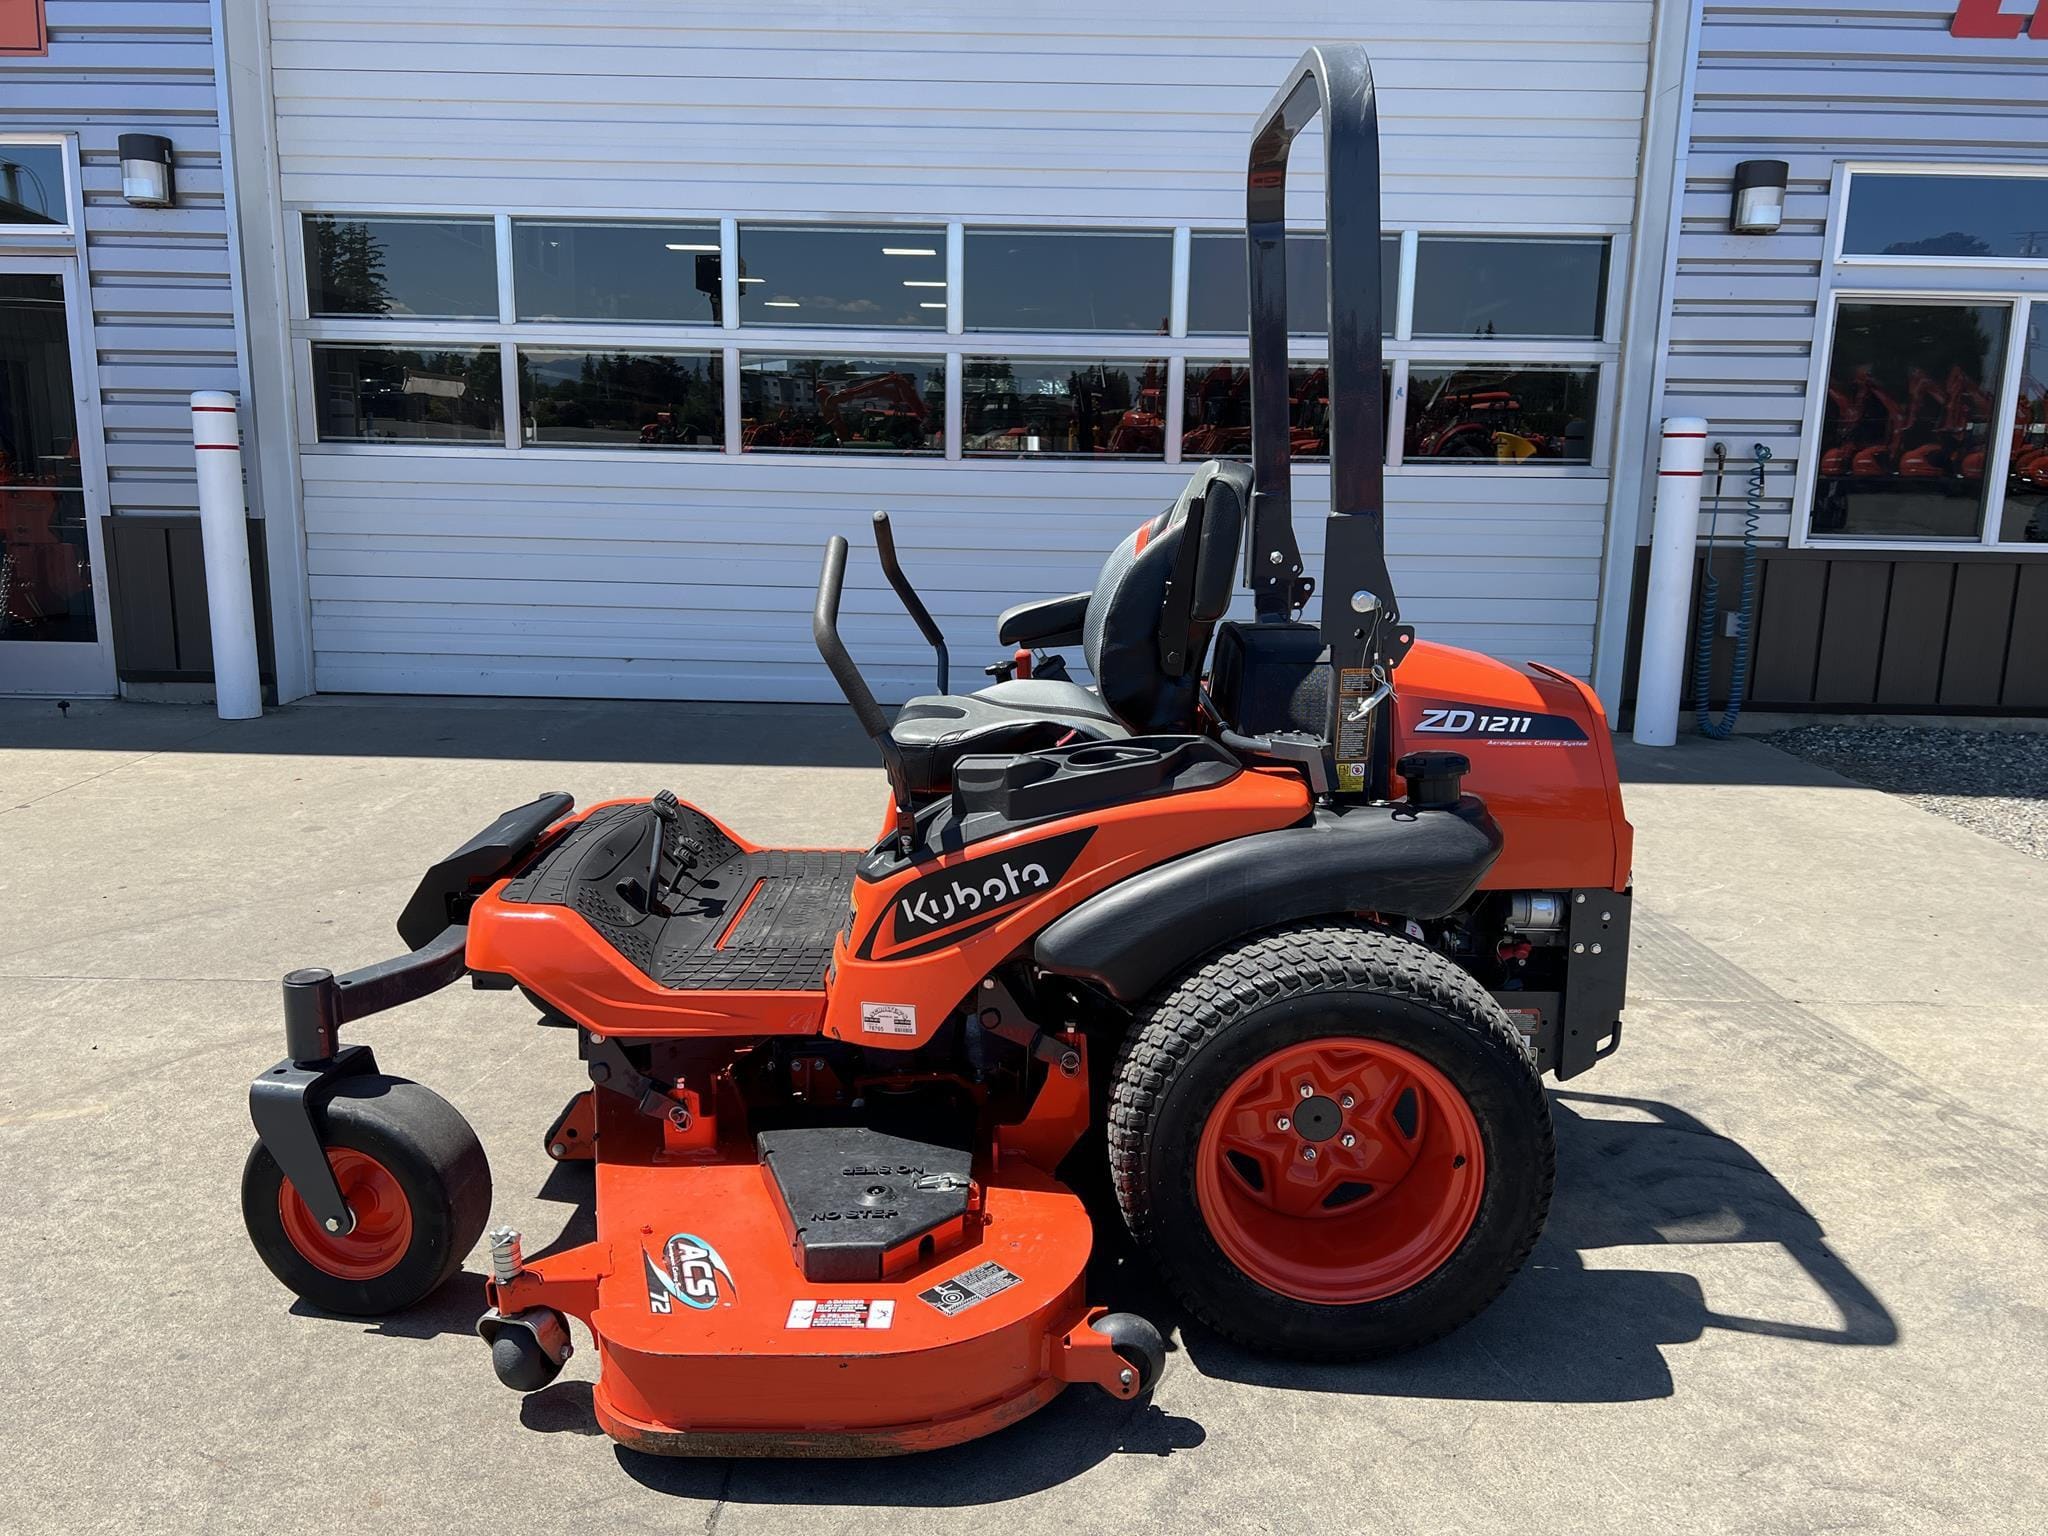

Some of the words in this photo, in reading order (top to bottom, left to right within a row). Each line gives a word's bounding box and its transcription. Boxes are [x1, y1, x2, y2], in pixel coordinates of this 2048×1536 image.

[901, 862, 1050, 924] Kubota
[842, 1165, 893, 1176] STEP
[896, 1164, 925, 1175] NO
[811, 1210, 842, 1222] NO
[846, 1208, 900, 1220] STEP
[677, 1242, 718, 1297] ACS
[650, 1291, 671, 1313] 72
